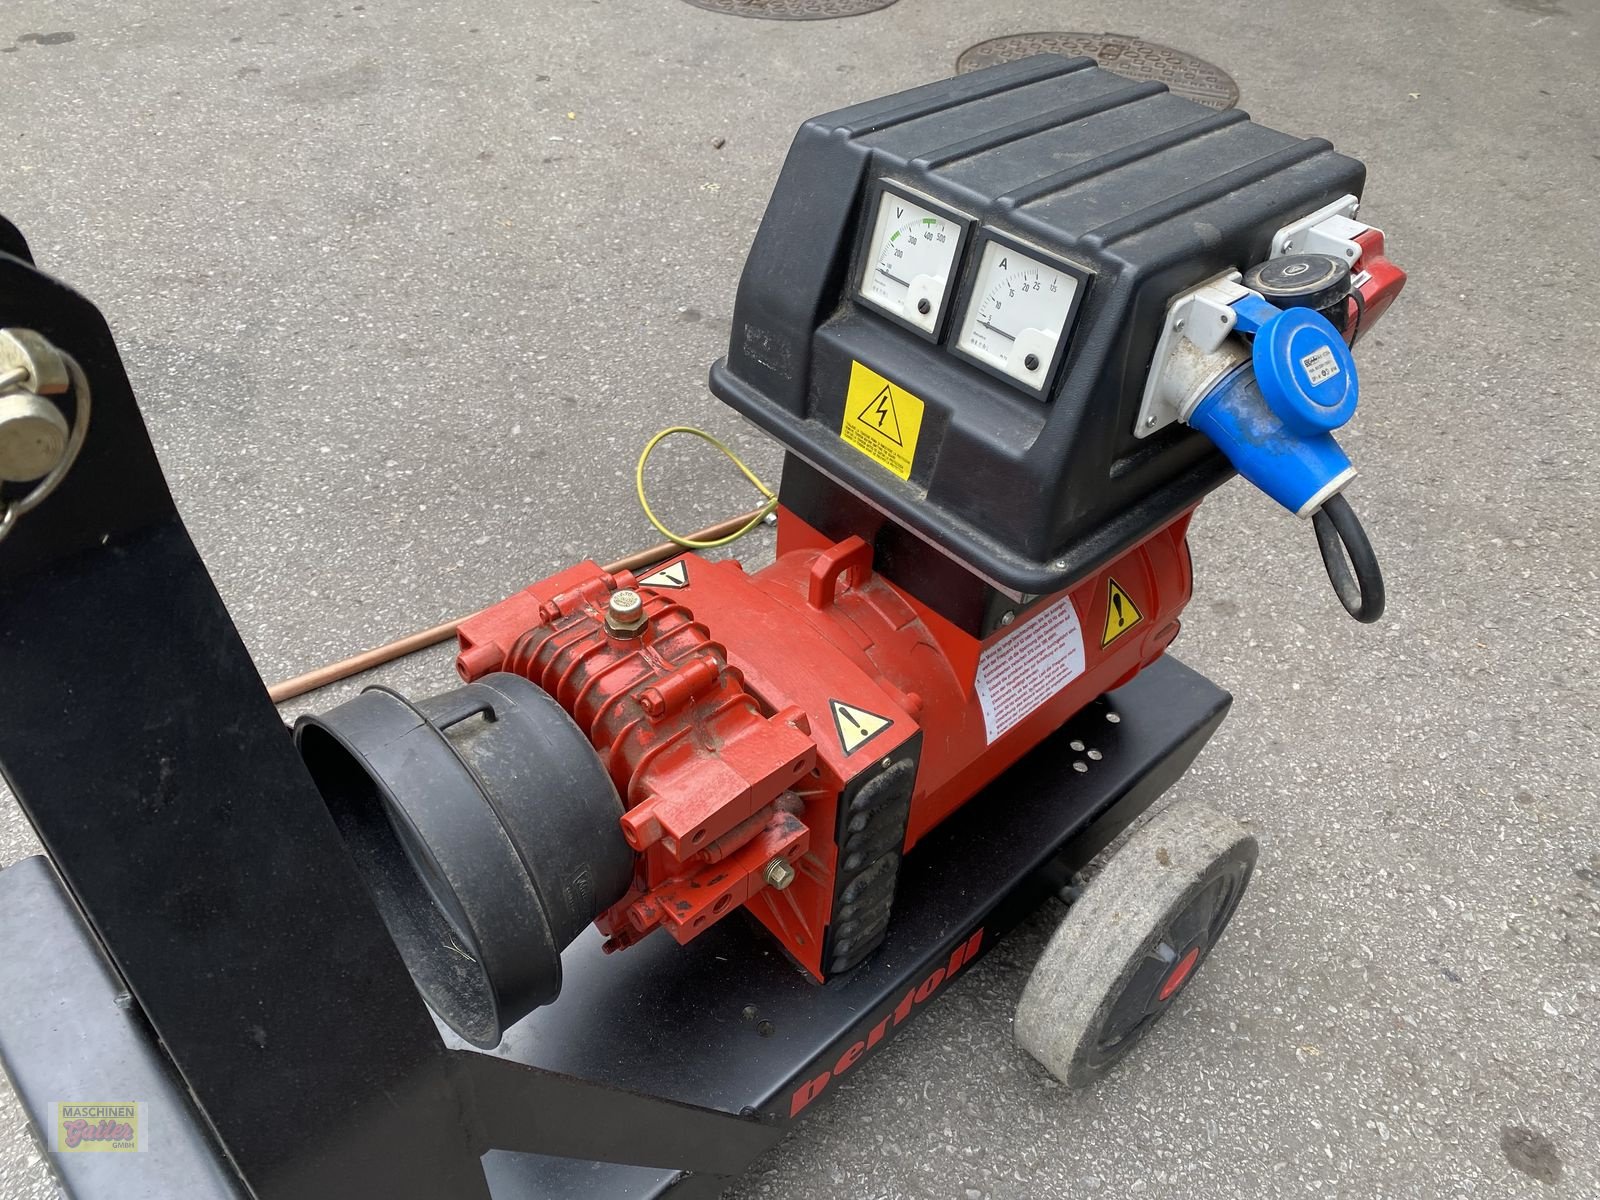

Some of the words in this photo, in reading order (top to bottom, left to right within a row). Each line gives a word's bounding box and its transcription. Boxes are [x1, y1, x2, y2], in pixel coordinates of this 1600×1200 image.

[896, 207, 904, 219] V
[907, 235, 918, 246] 300
[923, 231, 934, 242] 400
[936, 233, 946, 244] 500
[893, 248, 904, 259] 200
[998, 257, 1008, 270] A
[1021, 282, 1030, 293] 20
[1032, 281, 1041, 291] 25
[1008, 288, 1016, 298] 15
